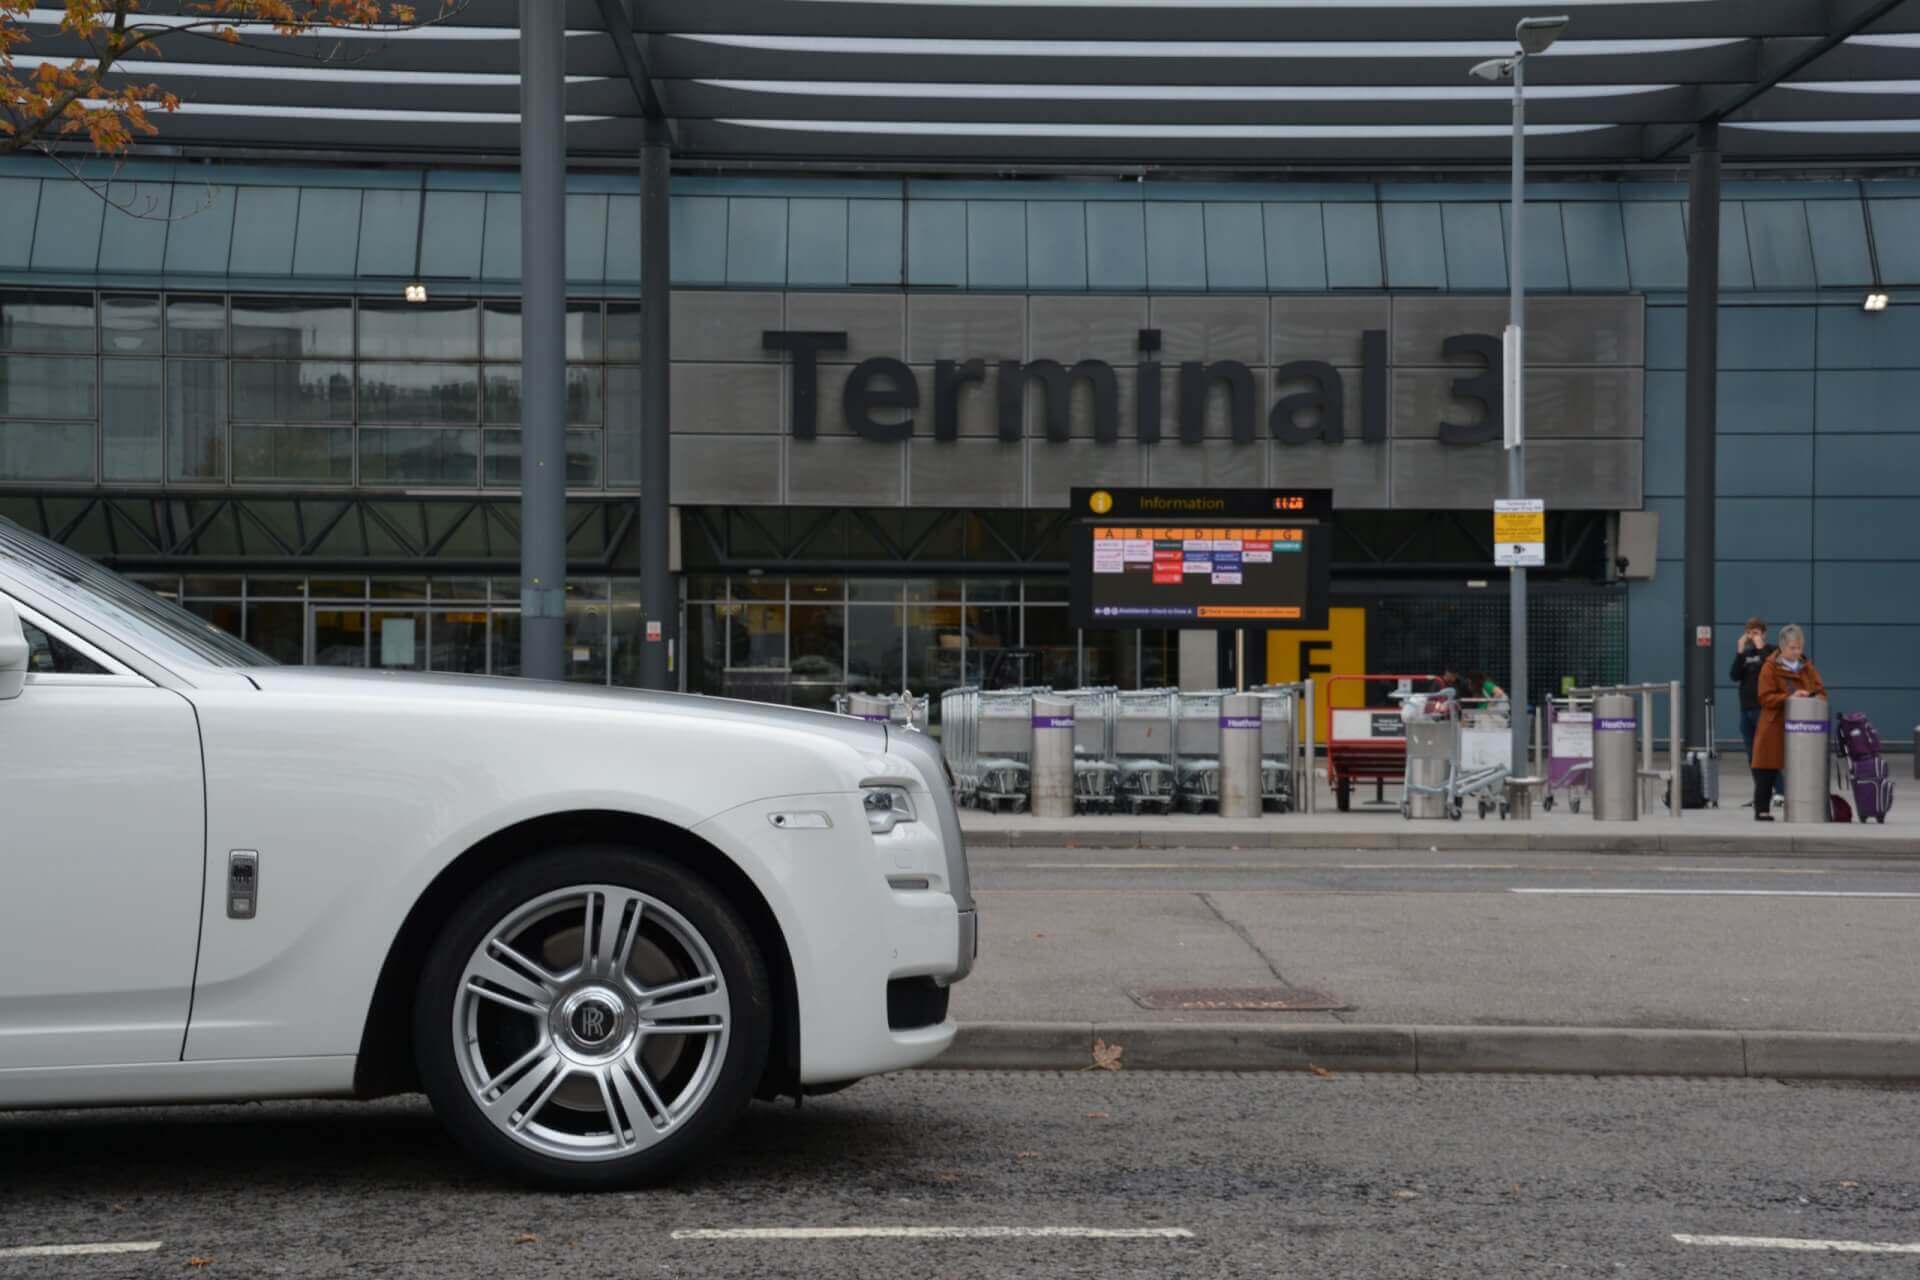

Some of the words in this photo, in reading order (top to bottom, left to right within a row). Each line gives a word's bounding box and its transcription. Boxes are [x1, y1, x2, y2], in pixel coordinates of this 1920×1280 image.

[762, 329, 1387, 445] Terminal
[1437, 333, 1503, 446] 3
[1139, 495, 1225, 510] Information
[1105, 528, 1114, 539] A
[1135, 528, 1143, 539] B
[1165, 528, 1173, 539] C
[1194, 528, 1203, 539] D
[1224, 528, 1231, 539] E
[1255, 528, 1261, 539] F
[1283, 529, 1292, 540] G
[1299, 639, 1333, 699] F
[582, 1007, 604, 1037] RR
